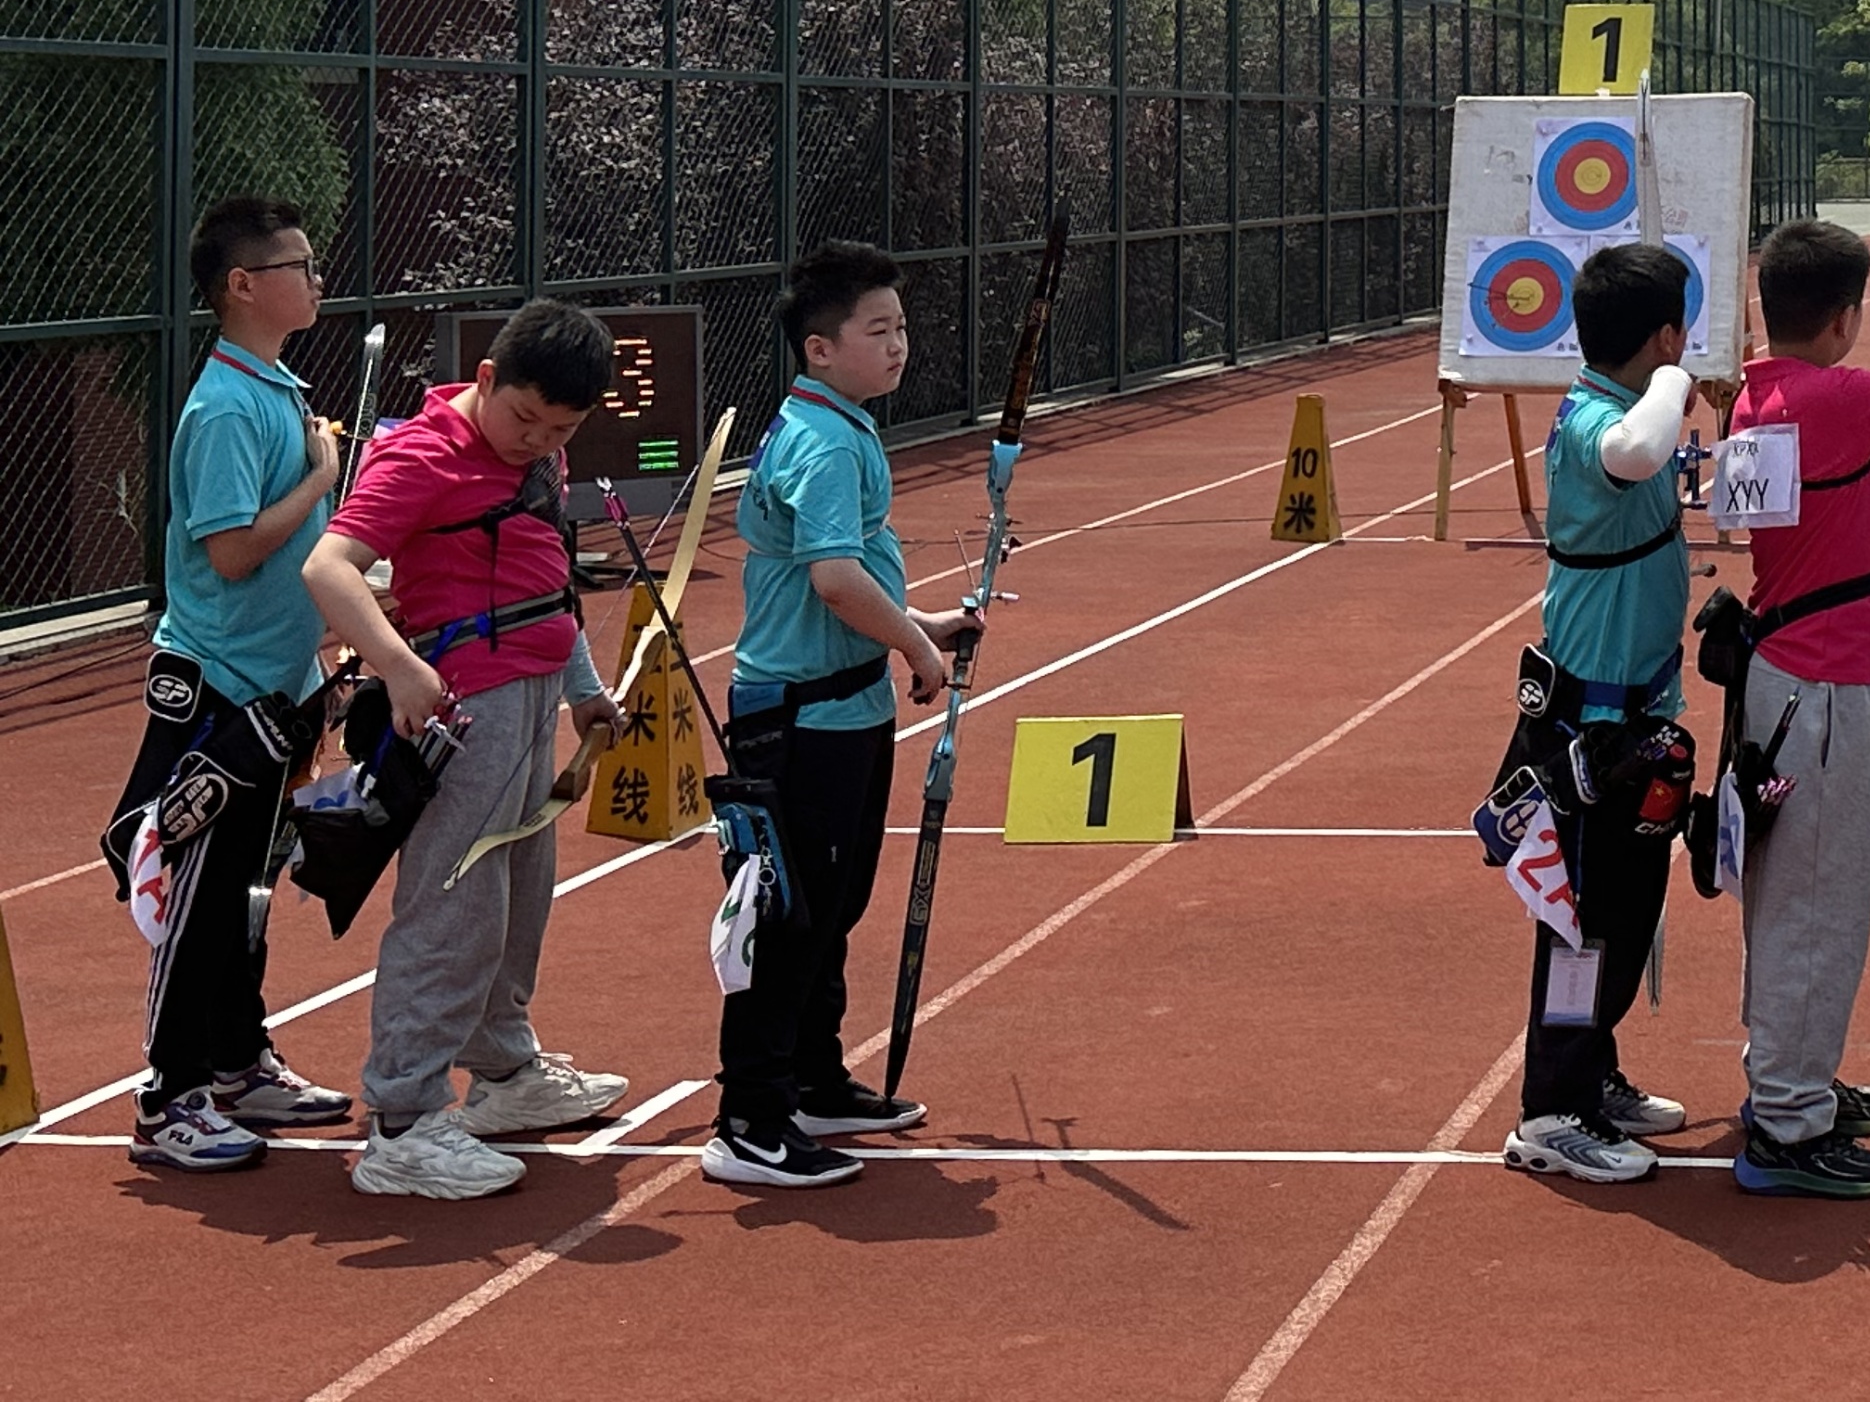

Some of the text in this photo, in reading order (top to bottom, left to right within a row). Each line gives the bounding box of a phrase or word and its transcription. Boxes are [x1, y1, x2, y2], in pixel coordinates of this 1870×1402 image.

[1592, 17, 1622, 82] 1
[1726, 478, 1769, 512] XYY
[1072, 732, 1117, 827] 1
[168, 1130, 194, 1146] FILA
